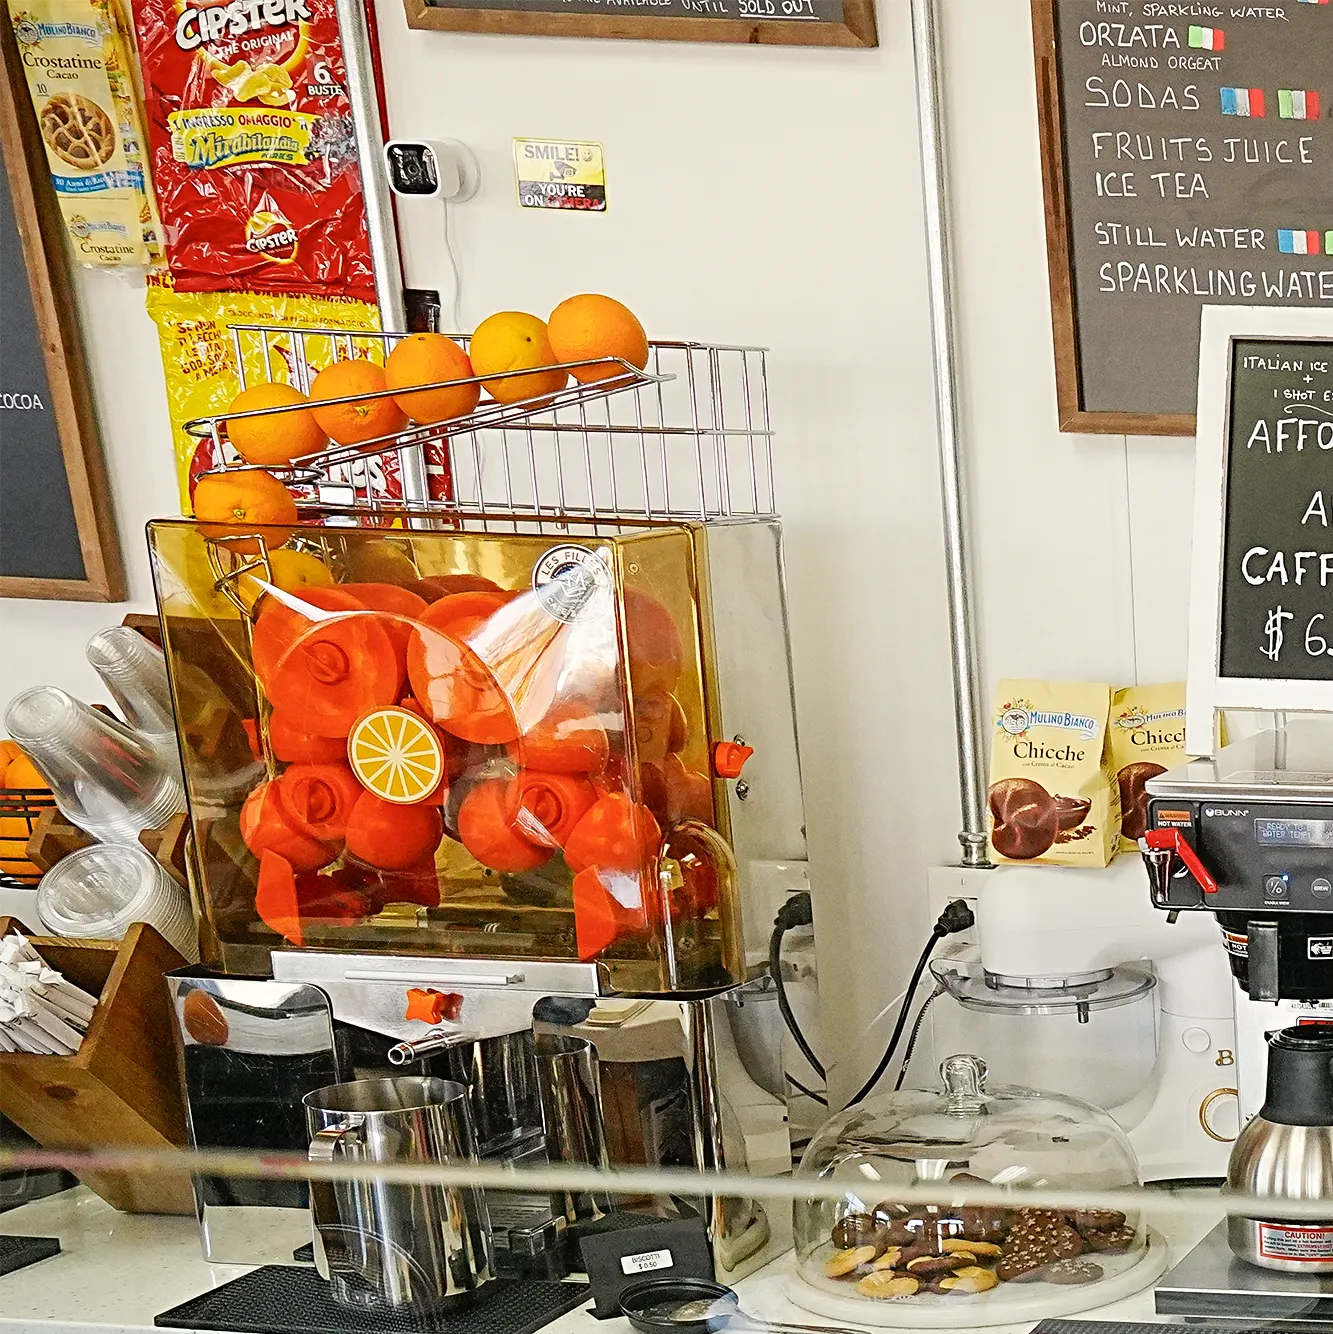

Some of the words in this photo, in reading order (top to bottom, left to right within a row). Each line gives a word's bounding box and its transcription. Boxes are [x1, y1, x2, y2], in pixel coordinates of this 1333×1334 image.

[175, 0, 312, 50] CIPSTER
[1079, 20, 1181, 49] ORZATA
[242, 32, 294, 53] ORIGINAL
[23, 52, 102, 69] Crostatine
[1101, 52, 1159, 69] ALMOND
[1167, 55, 1222, 71] ORGEAT
[46, 69, 79, 80] Cacao
[313, 62, 331, 84] 6
[307, 85, 343, 96] BUSTE
[1084, 76, 1200, 110] SODAS
[189, 132, 300, 169] Mirabilandia
[524, 144, 580, 161] SMILE!
[1091, 131, 1213, 162] FRUITS
[1223, 136, 1313, 164] JUICE
[539, 183, 586, 198] YOU'RE
[1095, 171, 1138, 197] ICE
[1150, 172, 1209, 199] TEA
[524, 194, 544, 207] ON
[545, 195, 602, 210] CAMERA
[246, 229, 298, 253] CIPSTER
[1094, 221, 1167, 247] STILL
[1175, 226, 1266, 250] WATER
[80, 242, 134, 255] Crostatine
[1310, 361, 1328, 373] ICE
[1283, 388, 1317, 401] SHOT
[1030, 711, 1063, 726] MULINO
[1064, 713, 1095, 730] BIANCO
[1013, 742, 1085, 762] Chicche
[1284, 1231, 1325, 1240] CAUTION!
[631, 1253, 661, 1264] BISCOTTI
